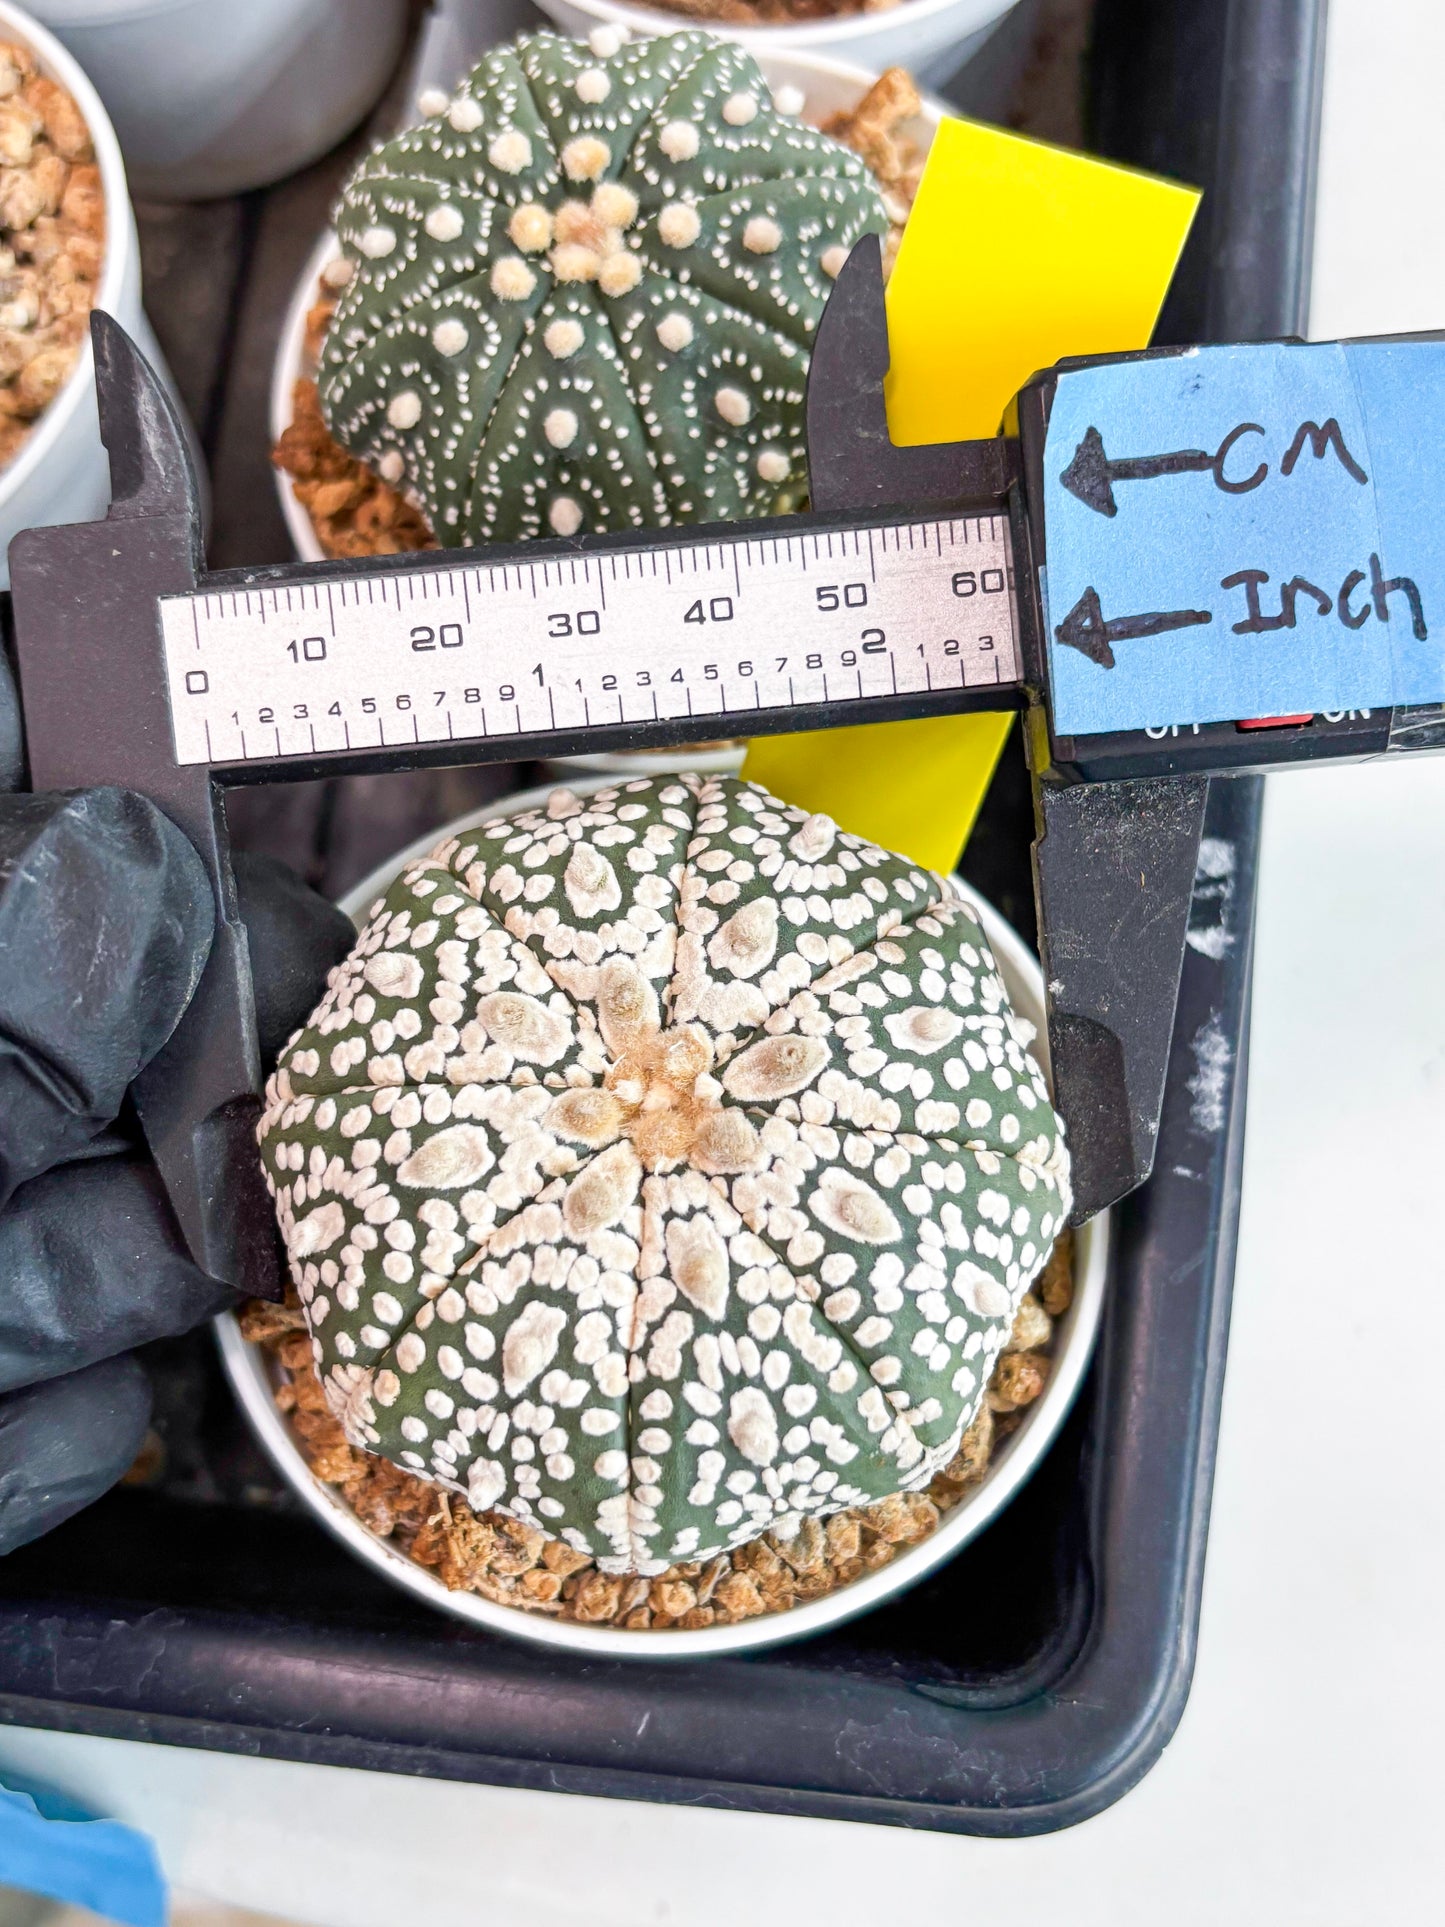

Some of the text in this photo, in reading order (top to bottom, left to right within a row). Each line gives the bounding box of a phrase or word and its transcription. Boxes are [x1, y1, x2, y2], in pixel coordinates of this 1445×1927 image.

[185, 568, 1005, 695] 0 10 20 30 40 50 60
[1220, 552, 1428, 642] Inch
[231, 628, 995, 726] 1 2 3 4 5 6 7 8 9 1 1 2 3 4 5 6 7 8 9 2 1 2 3
